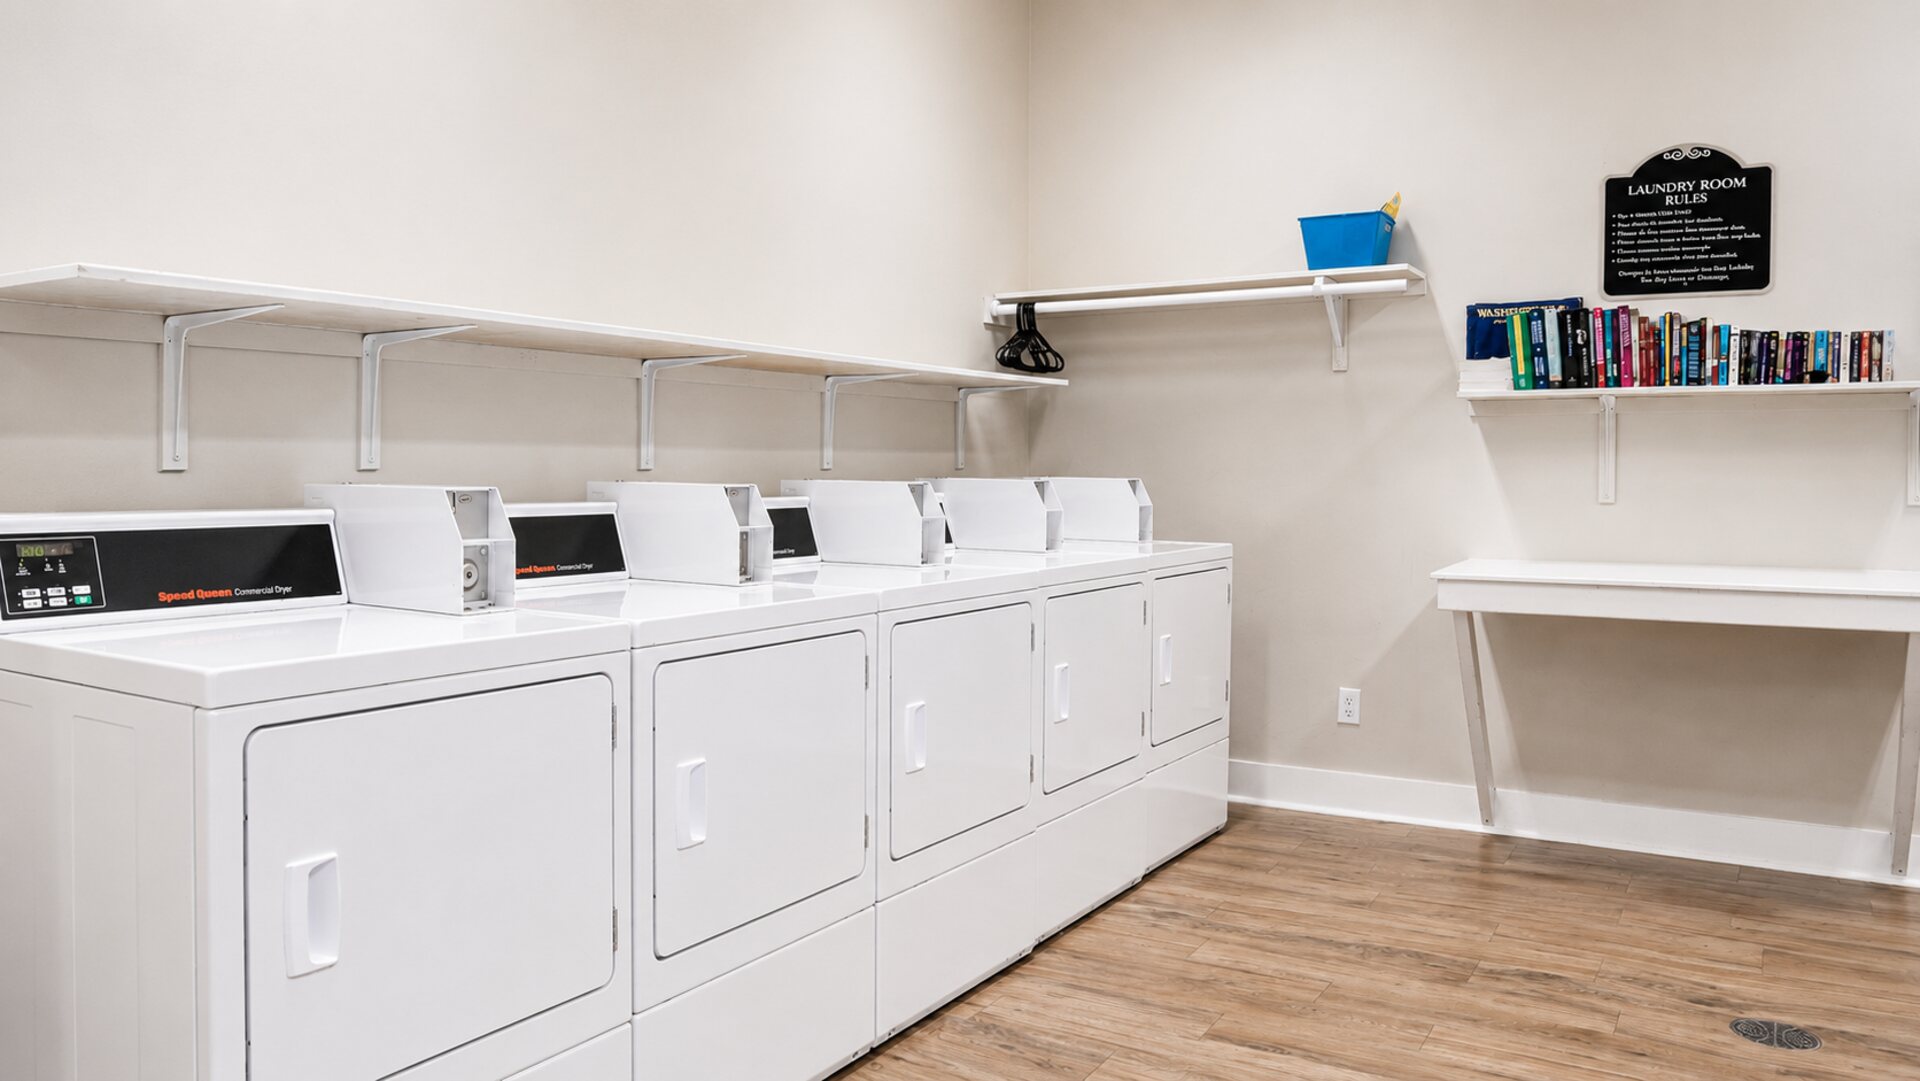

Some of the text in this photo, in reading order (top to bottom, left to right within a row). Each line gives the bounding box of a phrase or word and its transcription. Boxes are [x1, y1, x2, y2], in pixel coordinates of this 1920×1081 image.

[1628, 177, 1747, 196] LAUNDRY ROOM
[1665, 192, 1708, 206] RULES
[158, 585, 293, 602] Speed Queen Commercial Dryer
